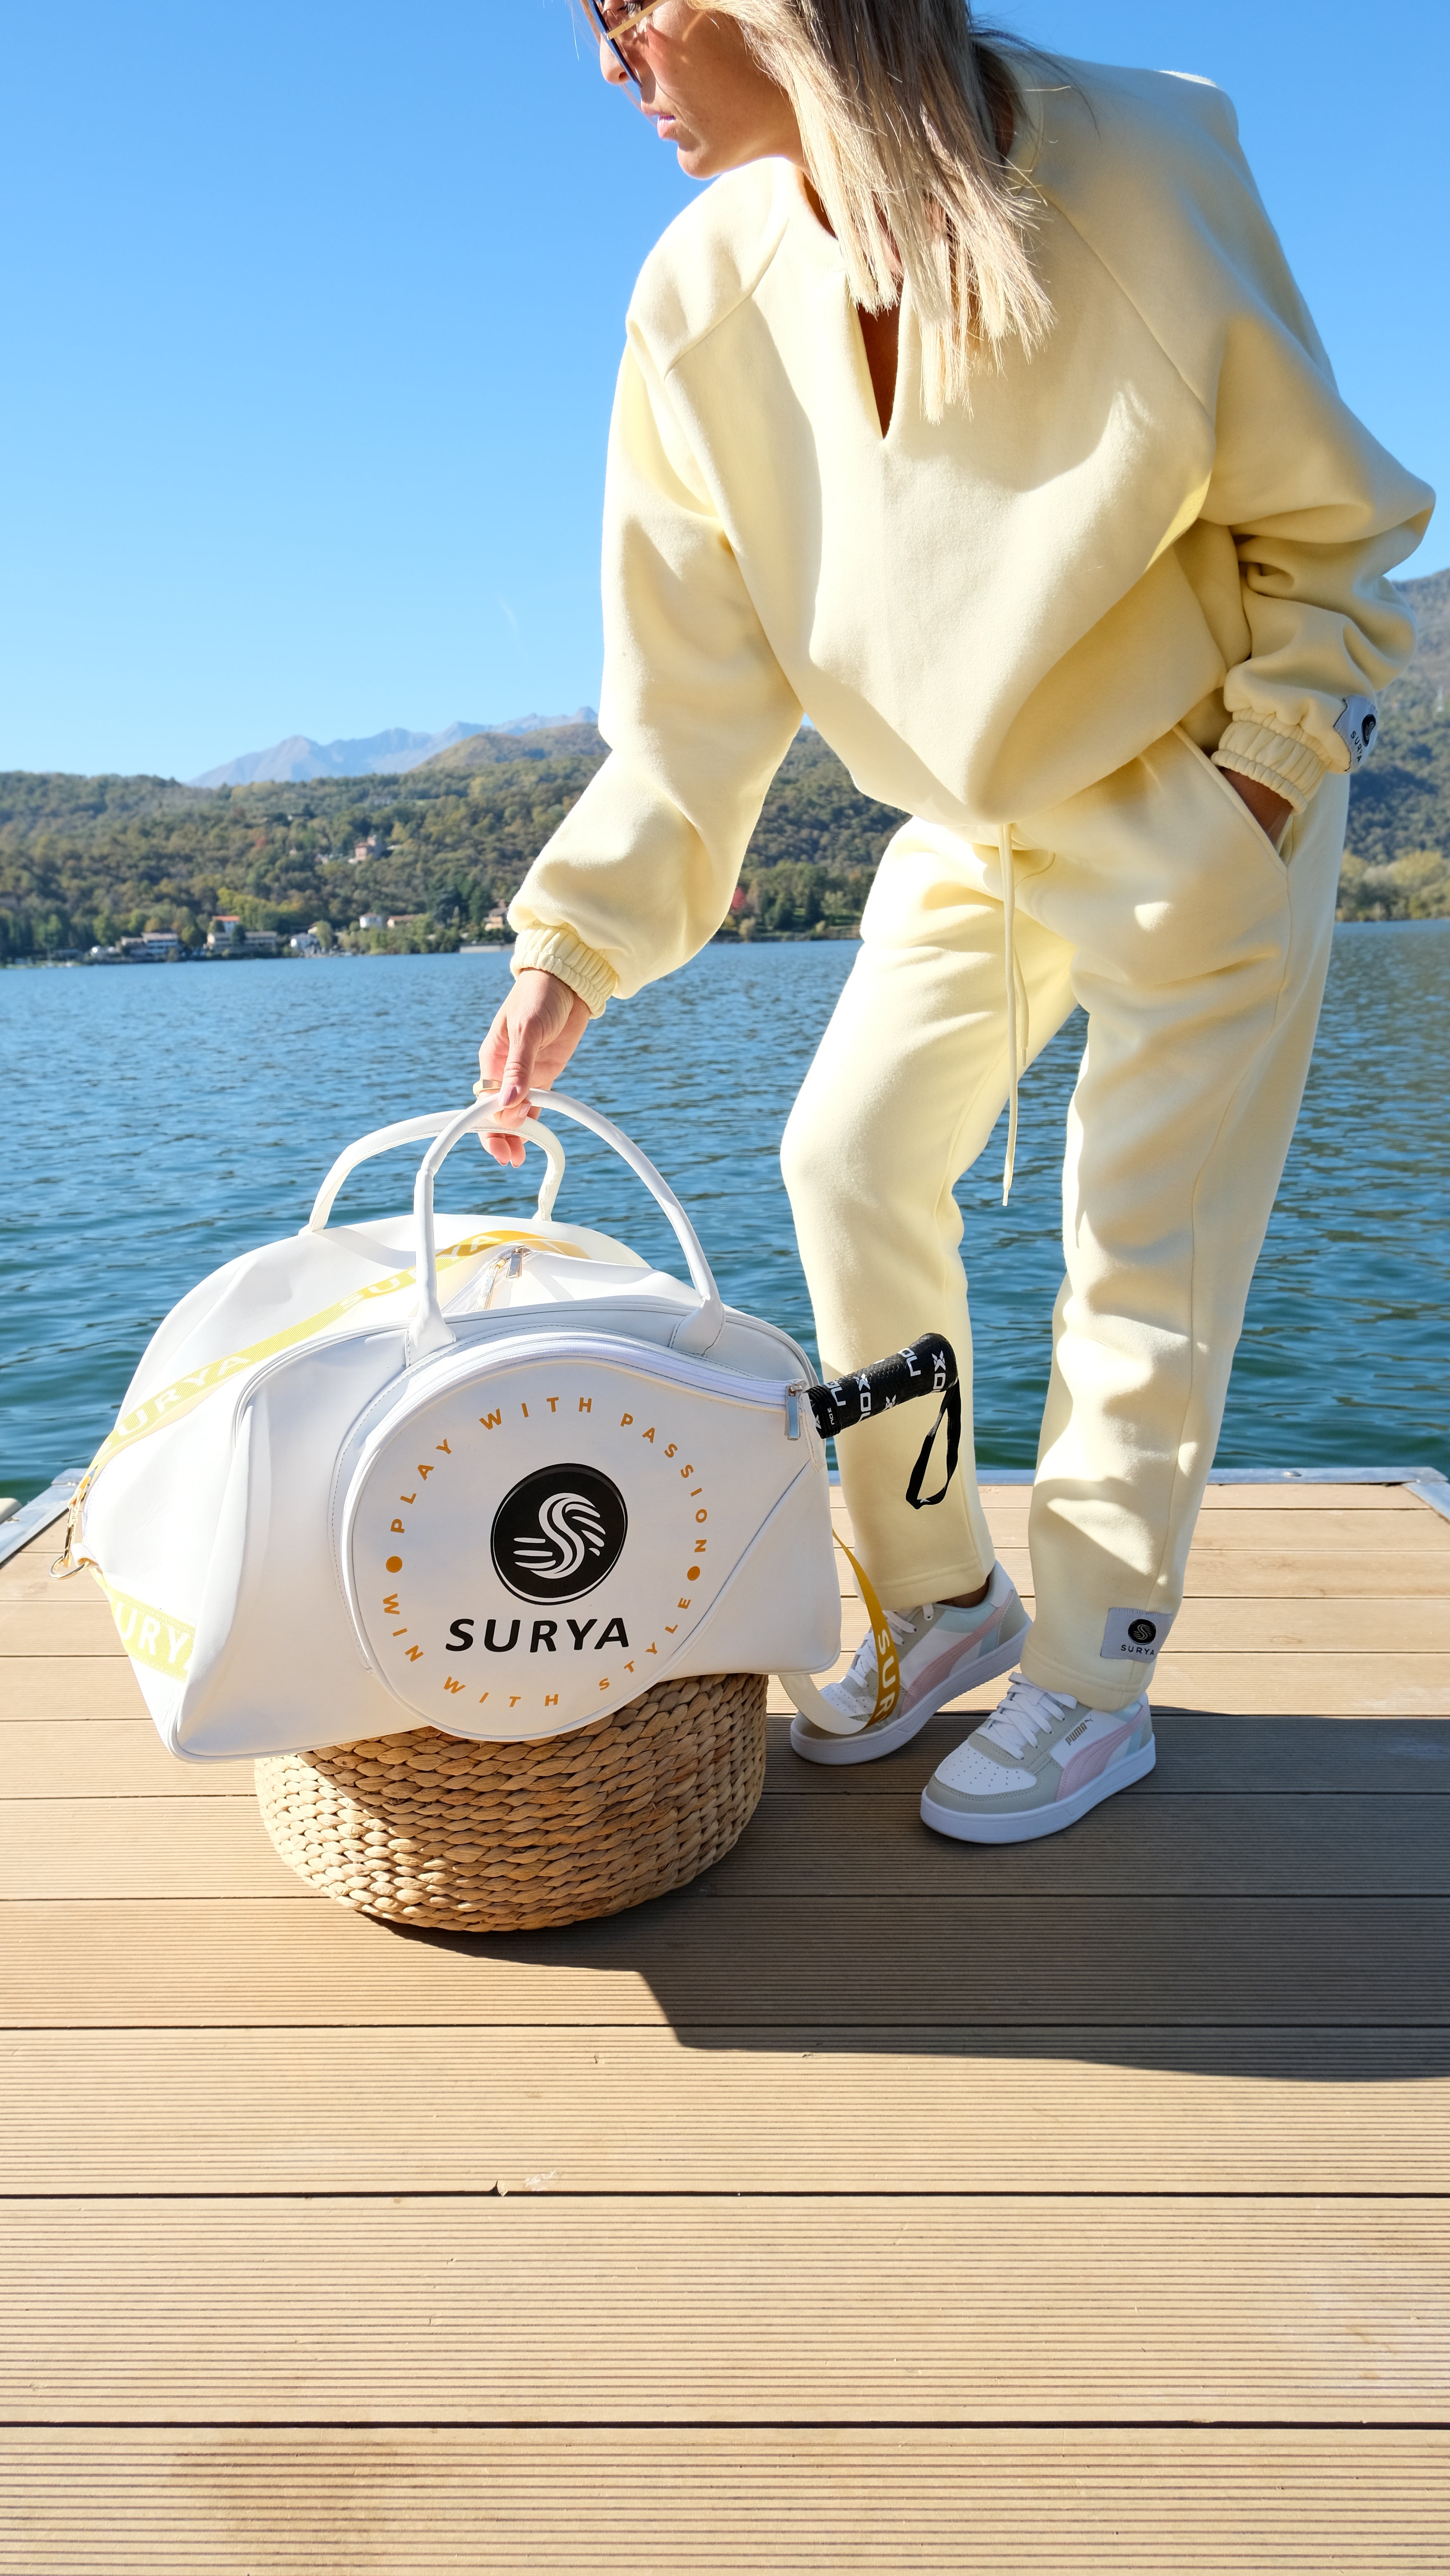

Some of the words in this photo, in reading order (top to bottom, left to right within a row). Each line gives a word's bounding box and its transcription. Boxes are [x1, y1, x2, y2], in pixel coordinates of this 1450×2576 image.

[1350, 731, 1362, 762] SURYA
[390, 1439, 452, 1533] PLAY
[479, 1397, 592, 1430] WITH
[621, 1413, 708, 1553] PASSION
[110, 1596, 192, 1670] URY
[382, 1593, 424, 1662] WIN
[443, 1676, 559, 1708] WITH
[598, 1597, 692, 1691] STYLE
[445, 1617, 629, 1653] SURYA
[1121, 1644, 1154, 1656] SURYA
[874, 1629, 896, 1723] SUR
[1065, 1722, 1088, 1746] PUMA
